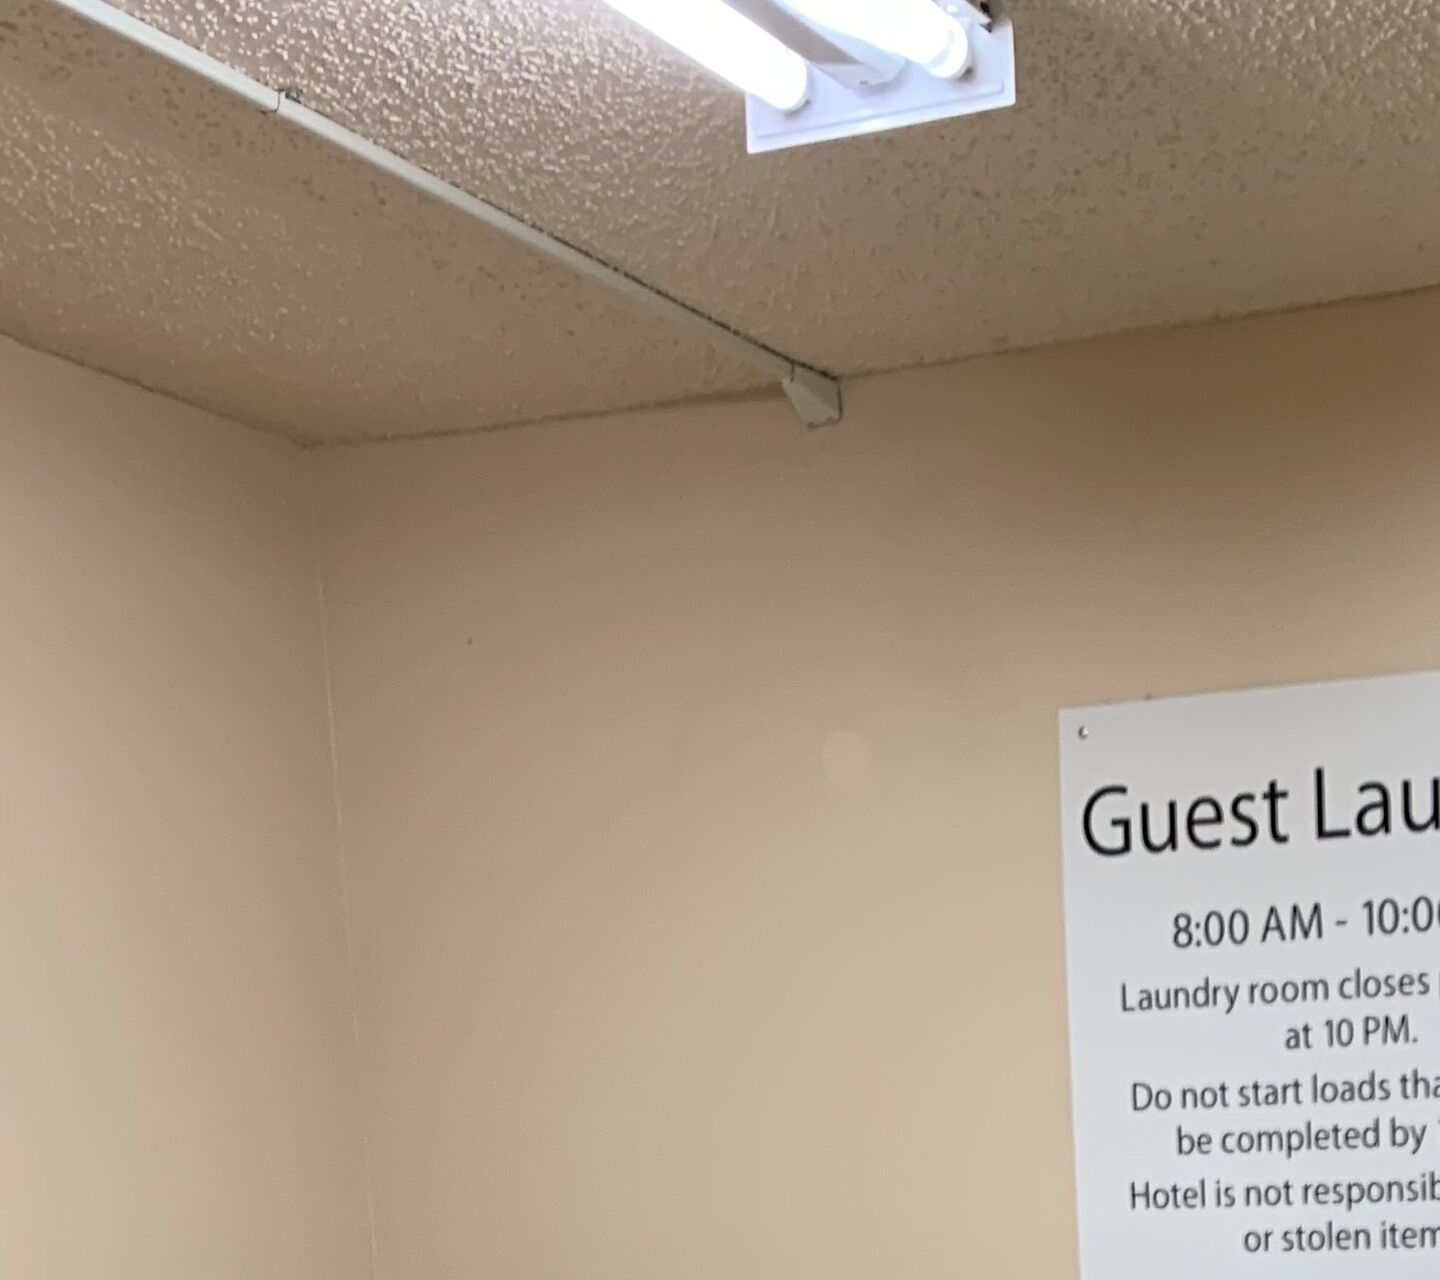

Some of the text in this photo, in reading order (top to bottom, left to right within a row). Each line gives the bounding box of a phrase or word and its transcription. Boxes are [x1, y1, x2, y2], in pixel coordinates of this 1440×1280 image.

[1080, 777, 1292, 860] Guest
[1170, 907, 1251, 951] 8:00
[1259, 900, 1325, 945] AM
[1119, 974, 1242, 1017] Laundry
[1246, 977, 1331, 1007] room
[1336, 965, 1432, 1002] closes
[1283, 1012, 1420, 1052] at 10 PM.
[1129, 1080, 1174, 1114] Do
[1179, 1080, 1231, 1111] not
[1236, 1076, 1305, 1109] start
[1309, 1068, 1393, 1106] loads
[1174, 1123, 1214, 1157] be
[1218, 1115, 1382, 1161] completed
[1388, 1114, 1429, 1157] by
[1128, 1176, 1208, 1212] Hotel
[1213, 1177, 1238, 1210] is
[1242, 1178, 1295, 1209] not
[1241, 1228, 1275, 1255] or
[1279, 1218, 1373, 1254] stolen
